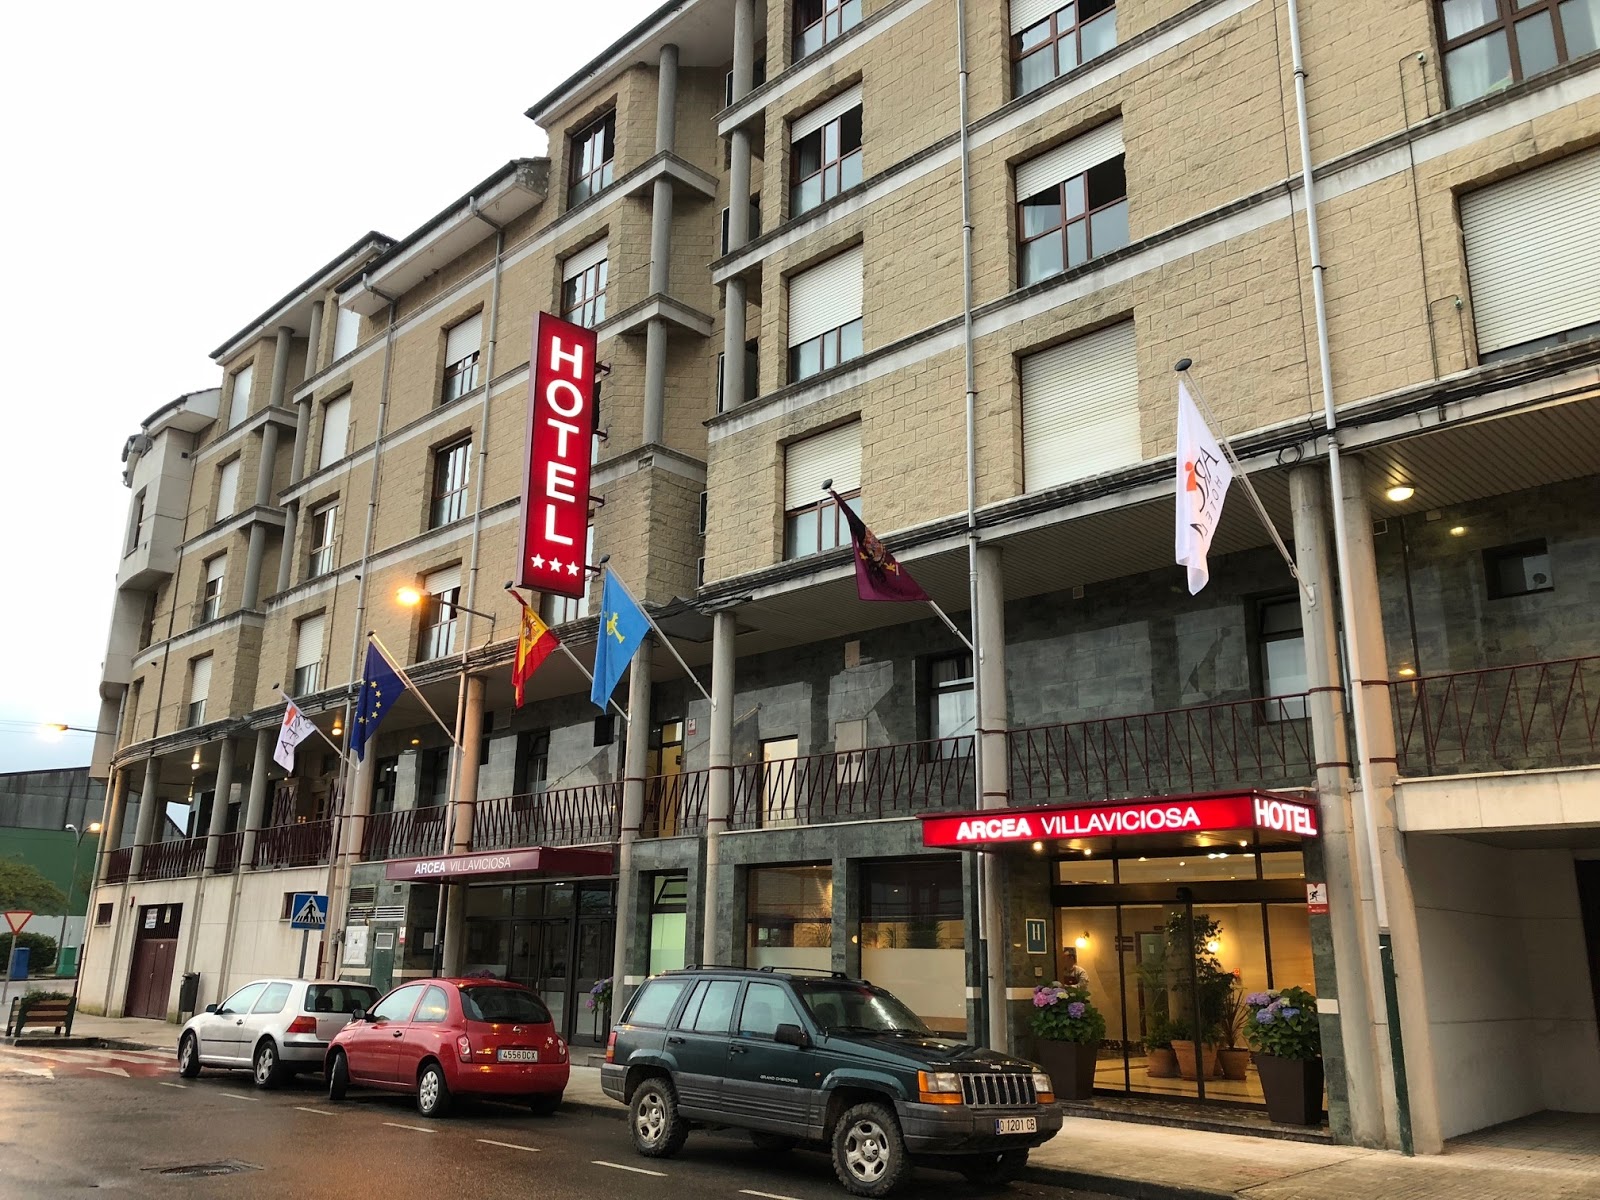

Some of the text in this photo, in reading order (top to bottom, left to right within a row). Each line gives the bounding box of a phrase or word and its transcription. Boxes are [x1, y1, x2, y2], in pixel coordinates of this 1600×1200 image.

[544, 336, 584, 546] HOTEL
[956, 807, 1201, 841] ARCEA VILLAVICIOSA
[1254, 798, 1318, 836] HOTEL
[414, 856, 511, 875] ARCEA VILLAVICIOSA
